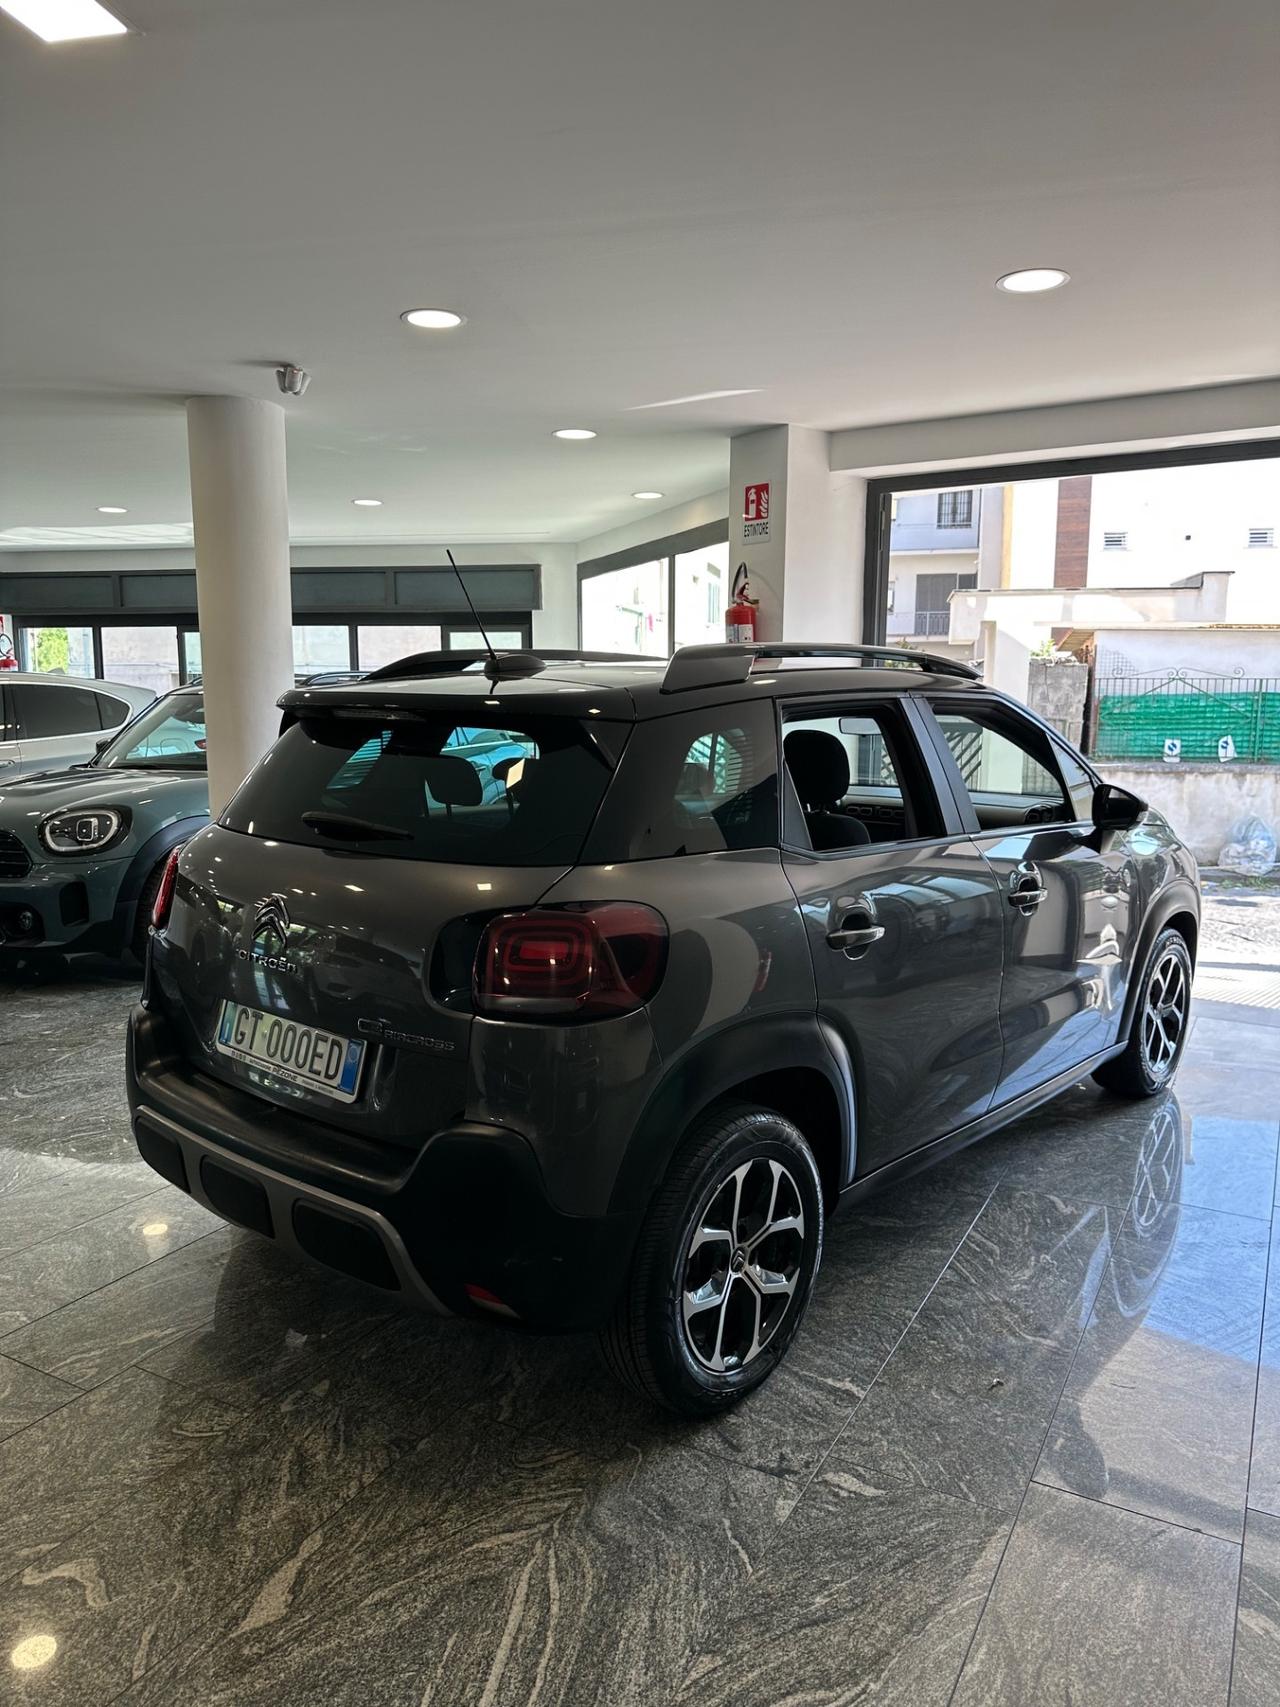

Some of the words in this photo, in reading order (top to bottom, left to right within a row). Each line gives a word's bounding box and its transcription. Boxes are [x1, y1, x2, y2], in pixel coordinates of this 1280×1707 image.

[743, 521, 769, 538] ESTINTORE
[234, 1007, 264, 1050] GT
[266, 1018, 343, 1081] 000ED
